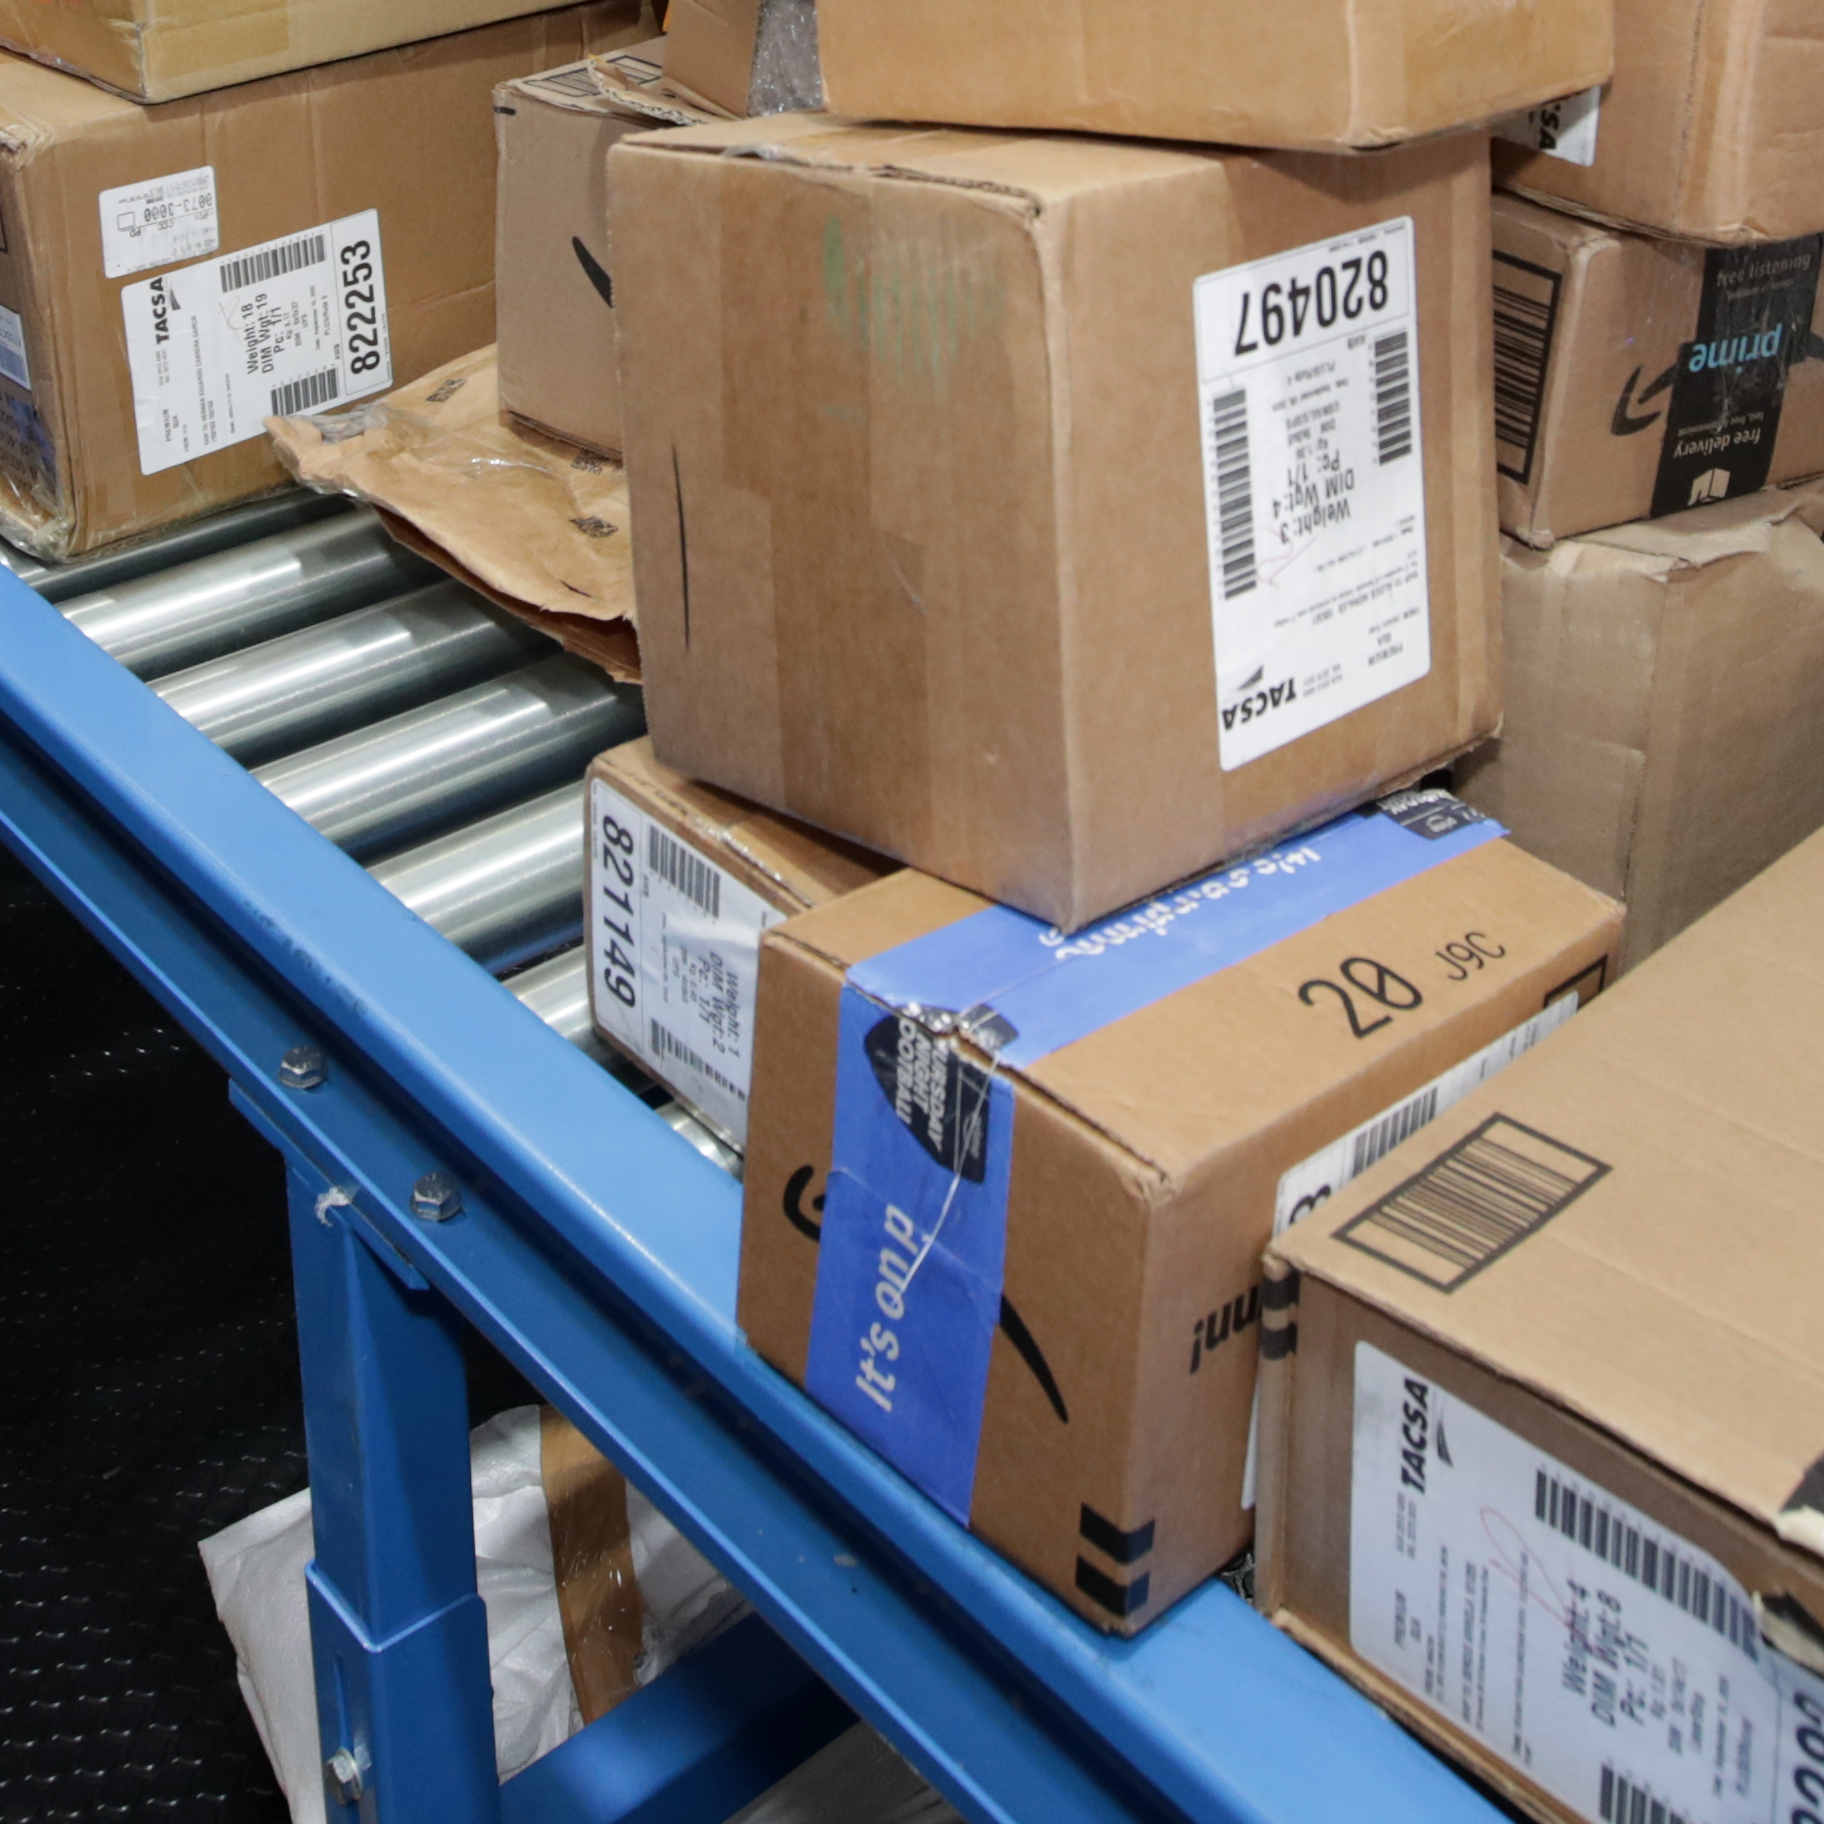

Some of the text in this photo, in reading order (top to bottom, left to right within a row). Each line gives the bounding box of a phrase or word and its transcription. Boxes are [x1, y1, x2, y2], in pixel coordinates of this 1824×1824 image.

[144, 193, 213, 222] 0073-3000
[1234, 249, 1388, 357] 820497
[1716, 252, 1811, 286] free listening
[149, 277, 170, 345] TACSA
[241, 303, 259, 374] Weight: 18
[255, 293, 274, 374] DIM Wgt: 19
[269, 307, 283, 353] Pc: 1/1
[340, 240, 380, 375] 822253
[333, 343, 341, 360] AWB
[1687, 323, 1785, 373] prime
[1287, 453, 1340, 484] Pc: 1/1
[1673, 427, 1763, 459] free delivery
[1272, 468, 1355, 518] DIM Wgt: 4
[1279, 497, 1351, 544] Weight: 3
[1367, 642, 1404, 667] PREMIUM
[1222, 679, 1297, 732] TACSA
[603, 816, 636, 1008] 821149
[708, 951, 725, 1055] DIM Wgt: 2
[726, 972, 739, 1042] Weight:
[1298, 930, 1506, 1039] 20 J9C
[911, 1028, 929, 1115] NIGHT
[856, 1240, 913, 1411] It's on
[1401, 1376, 1429, 1495] TACSA
[1562, 1579, 1594, 1695] Weight: 4
[1591, 1589, 1623, 1727] DIM Wgt: 8
[1619, 1628, 1649, 1727] Pc: 1/1
